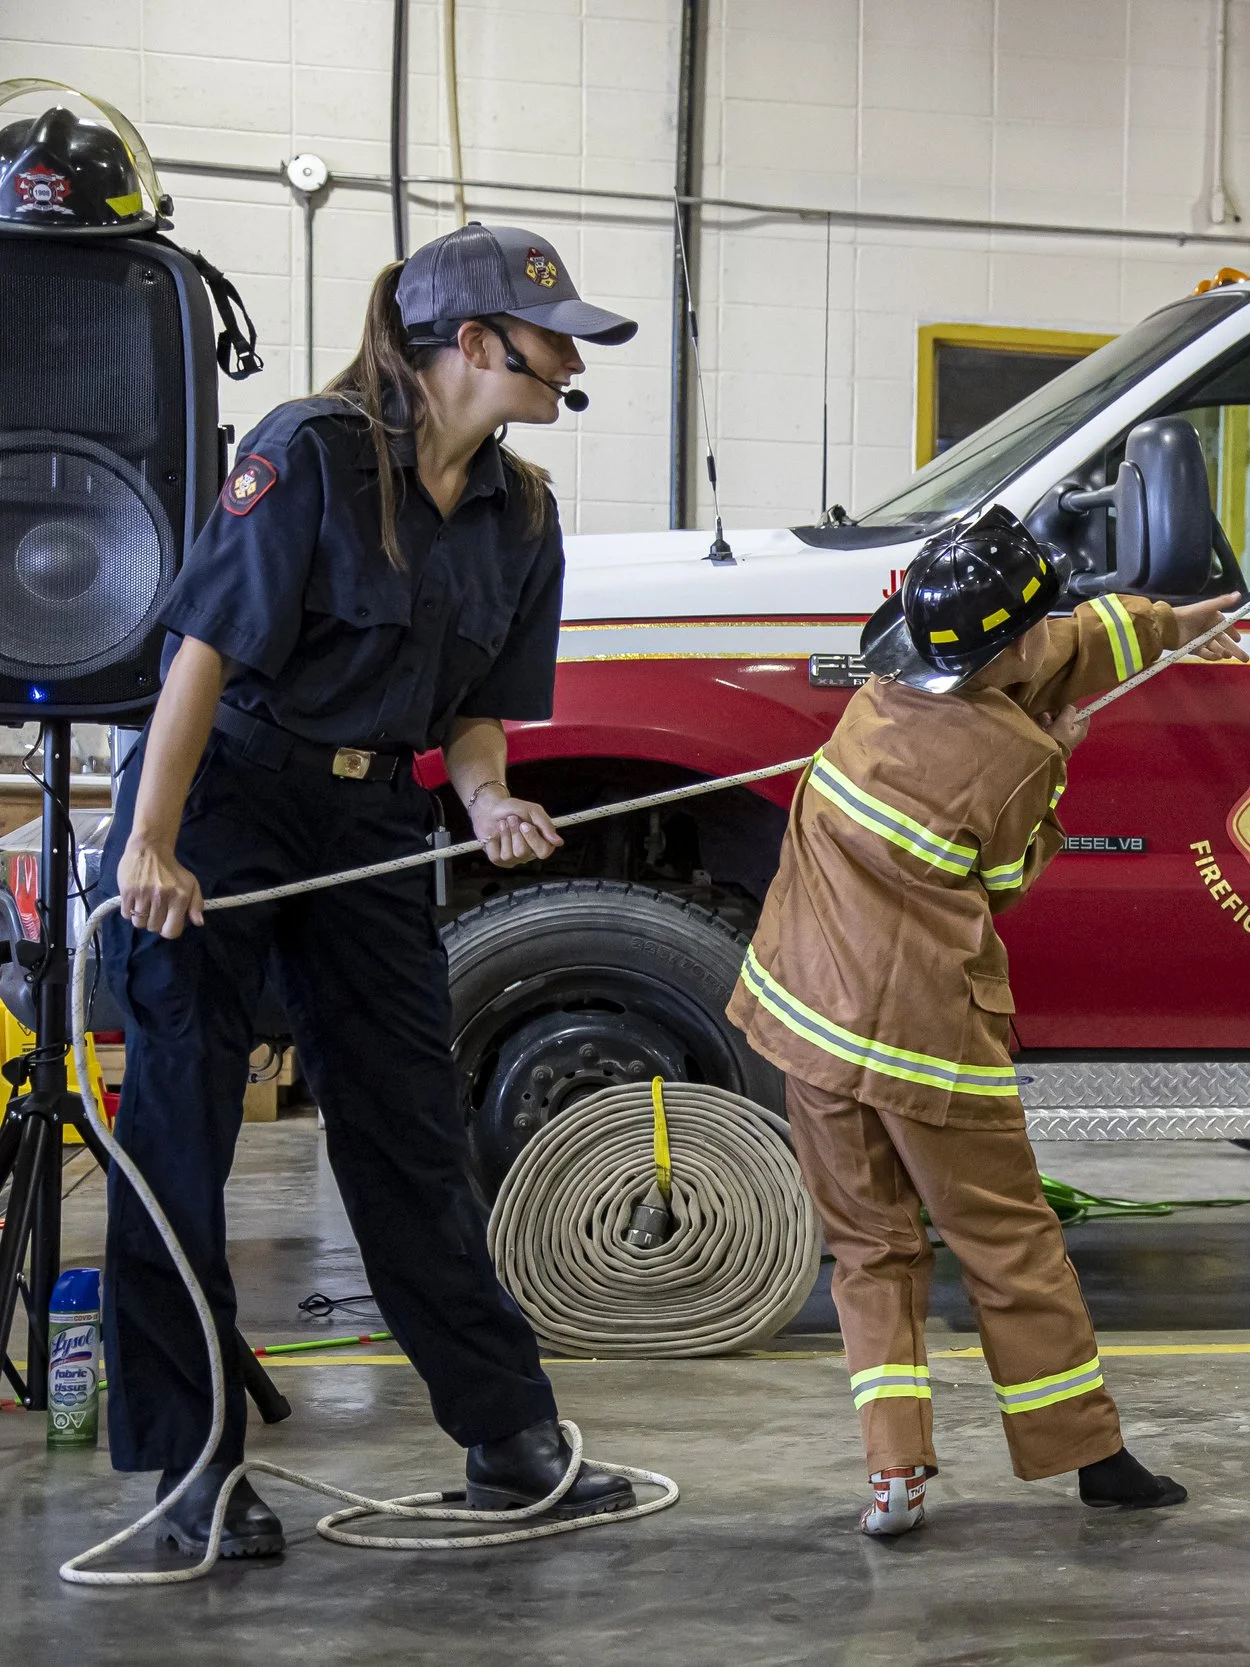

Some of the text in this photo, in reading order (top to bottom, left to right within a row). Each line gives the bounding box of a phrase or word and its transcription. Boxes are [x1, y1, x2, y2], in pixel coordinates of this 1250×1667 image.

[1060, 837, 1143, 850] IESEL V8
[53, 1327, 94, 1357] Lysol
[55, 1368, 87, 1379] fabric
[54, 1383, 87, 1392] tissus
[910, 1484, 925, 1498] TNT
